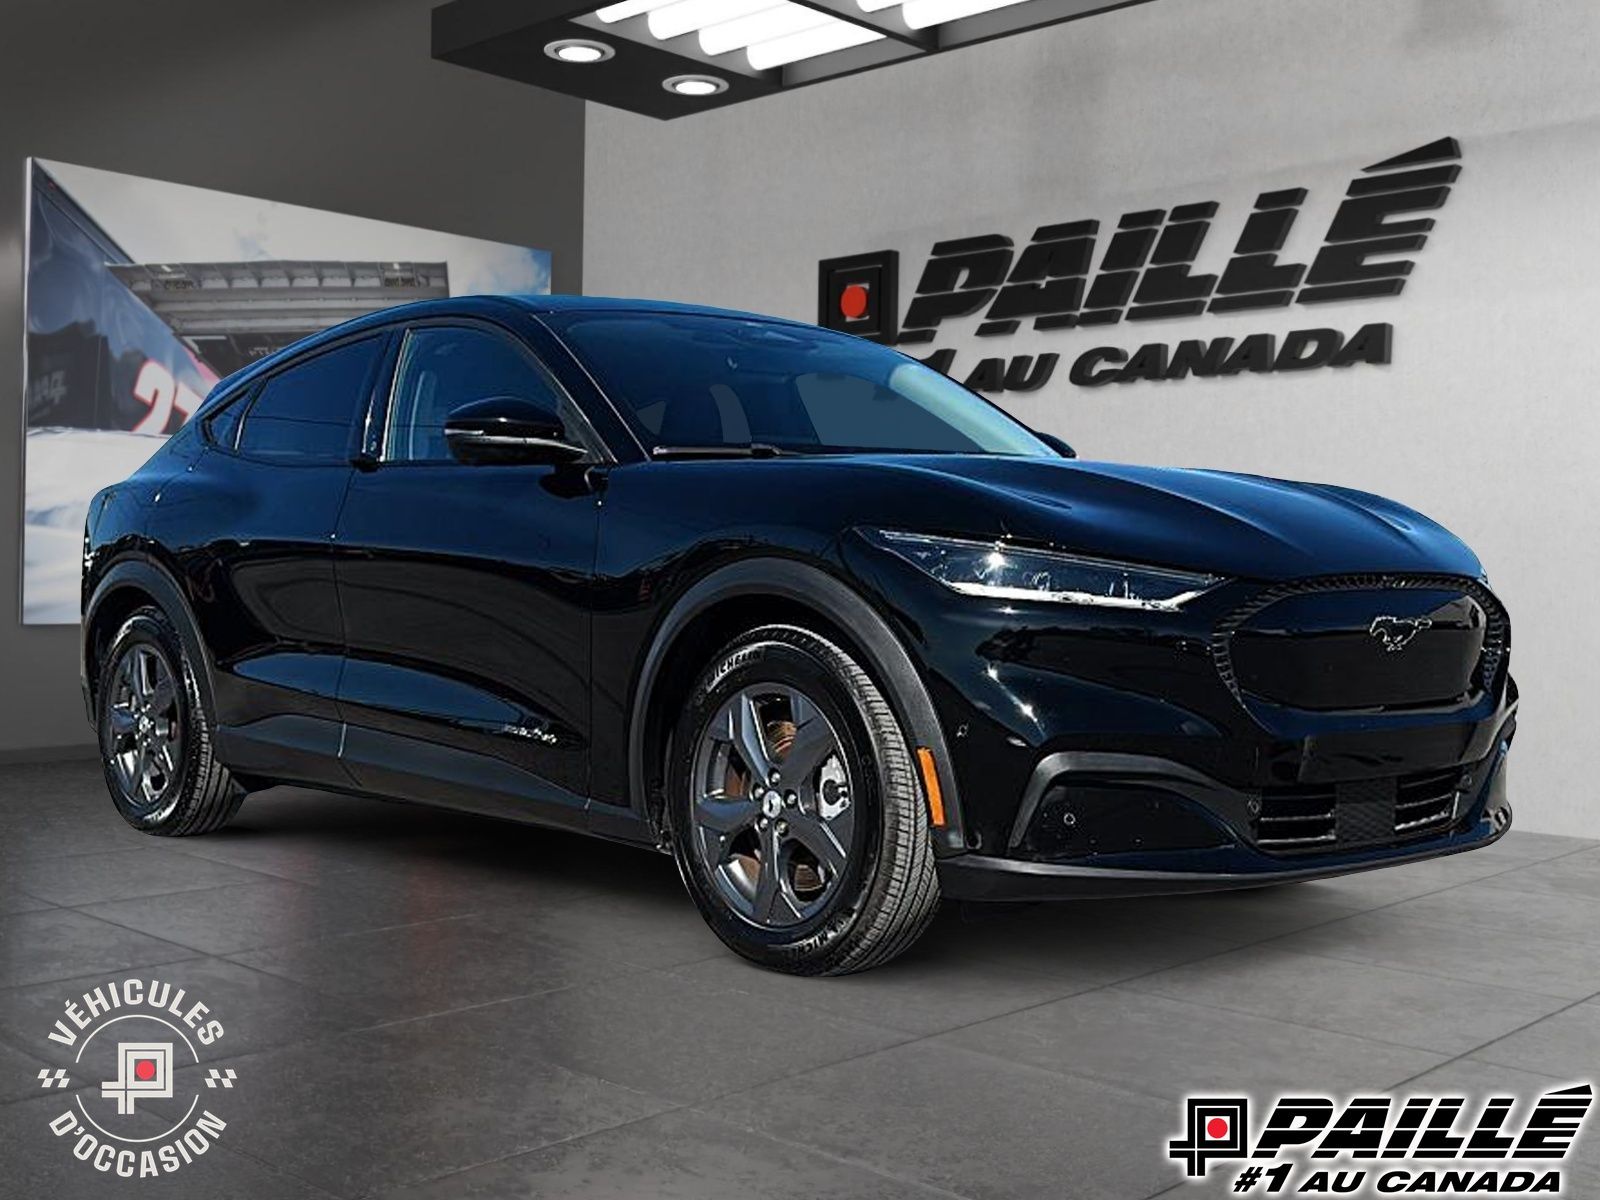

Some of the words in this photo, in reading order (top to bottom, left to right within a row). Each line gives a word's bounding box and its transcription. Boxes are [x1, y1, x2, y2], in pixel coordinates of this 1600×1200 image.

[898, 136, 1461, 343] PAILLÉ
[963, 353, 1060, 393] AU
[1069, 322, 1393, 388] CANADA
